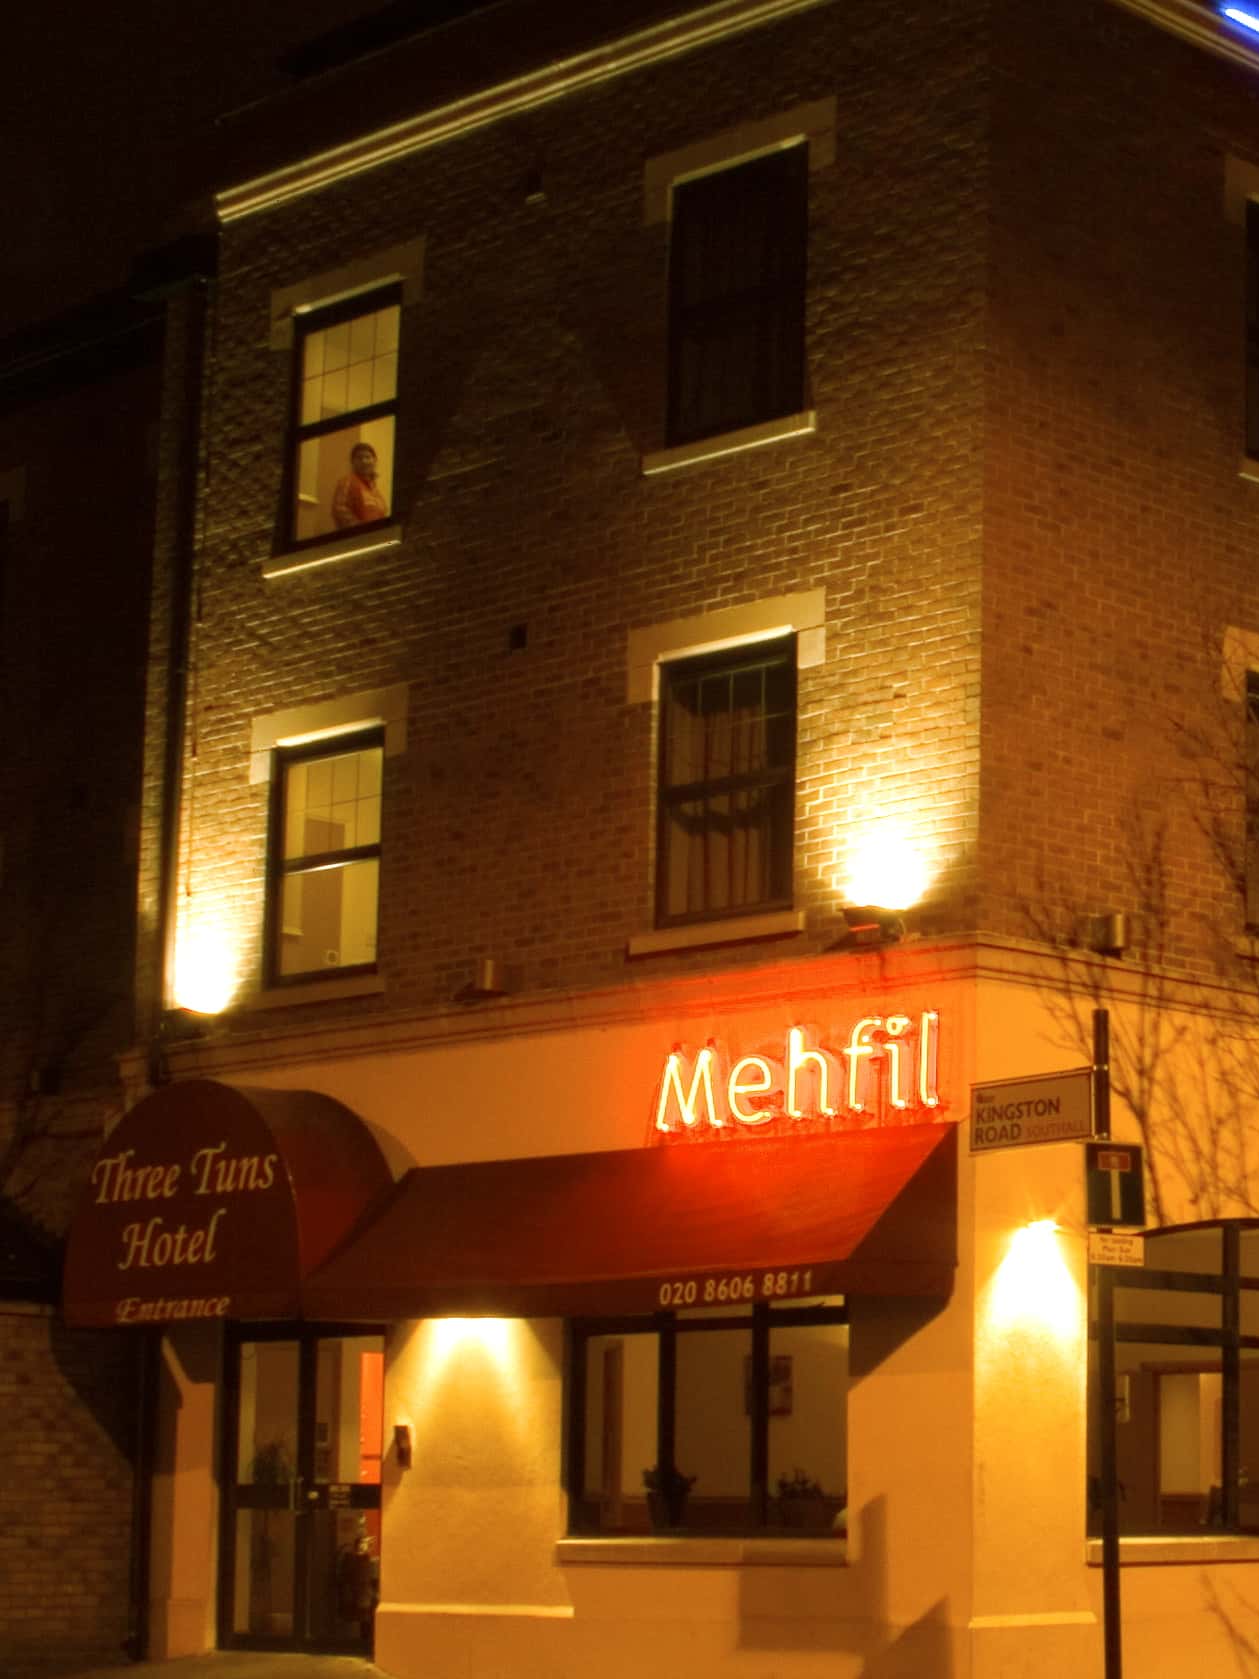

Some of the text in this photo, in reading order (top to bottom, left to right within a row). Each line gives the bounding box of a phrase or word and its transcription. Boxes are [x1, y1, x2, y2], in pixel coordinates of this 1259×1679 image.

[656, 1010, 940, 1132] Mehfil
[975, 1096, 1061, 1125] KINGSTON
[974, 1123, 1022, 1145] ROAD
[91, 1140, 278, 1204] Three Tuns
[117, 1208, 228, 1271] Hotel
[659, 1269, 813, 1306] 020 8606 8811
[116, 1296, 231, 1325] Entrance
